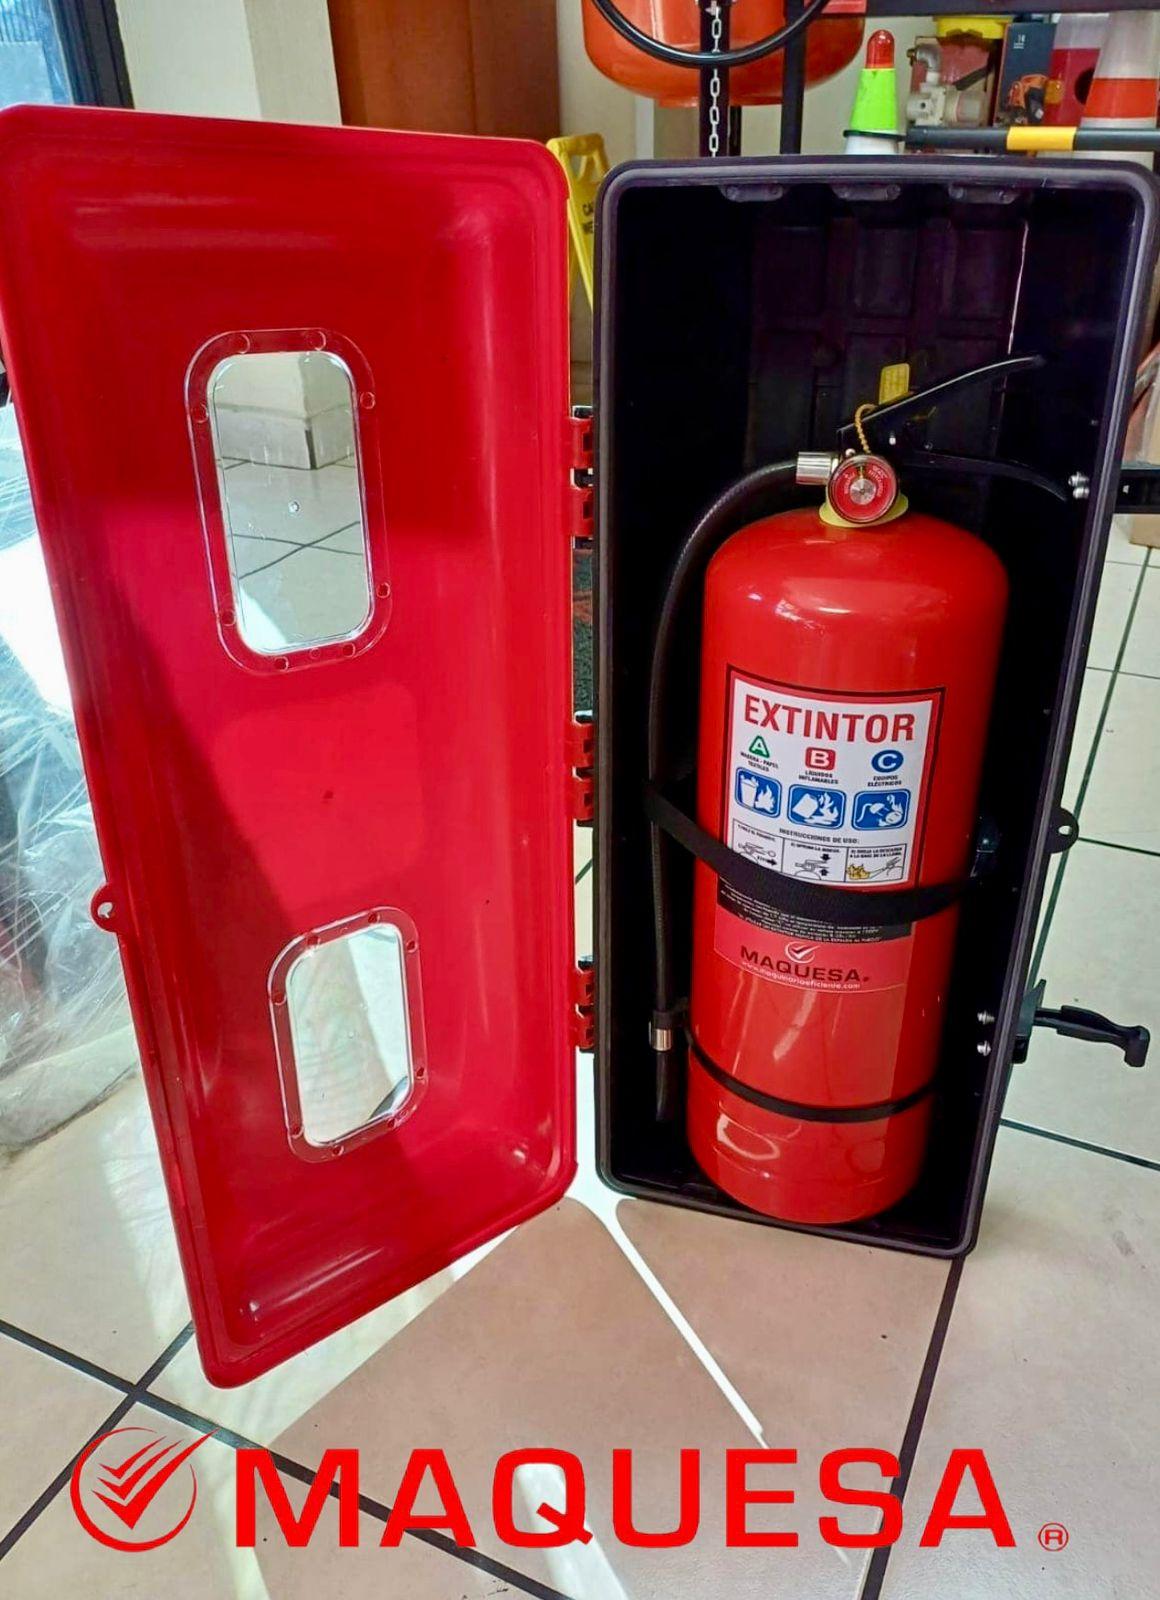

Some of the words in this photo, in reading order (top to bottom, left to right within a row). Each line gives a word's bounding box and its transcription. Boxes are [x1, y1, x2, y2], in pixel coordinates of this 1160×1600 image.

[744, 694, 916, 743] EXTINTOR
[749, 735, 770, 758] A
[810, 750, 830, 767] B
[877, 753, 898, 770] C
[779, 828, 831, 842] INSTRUCCIONES
[741, 945, 860, 982] MAQUESA
